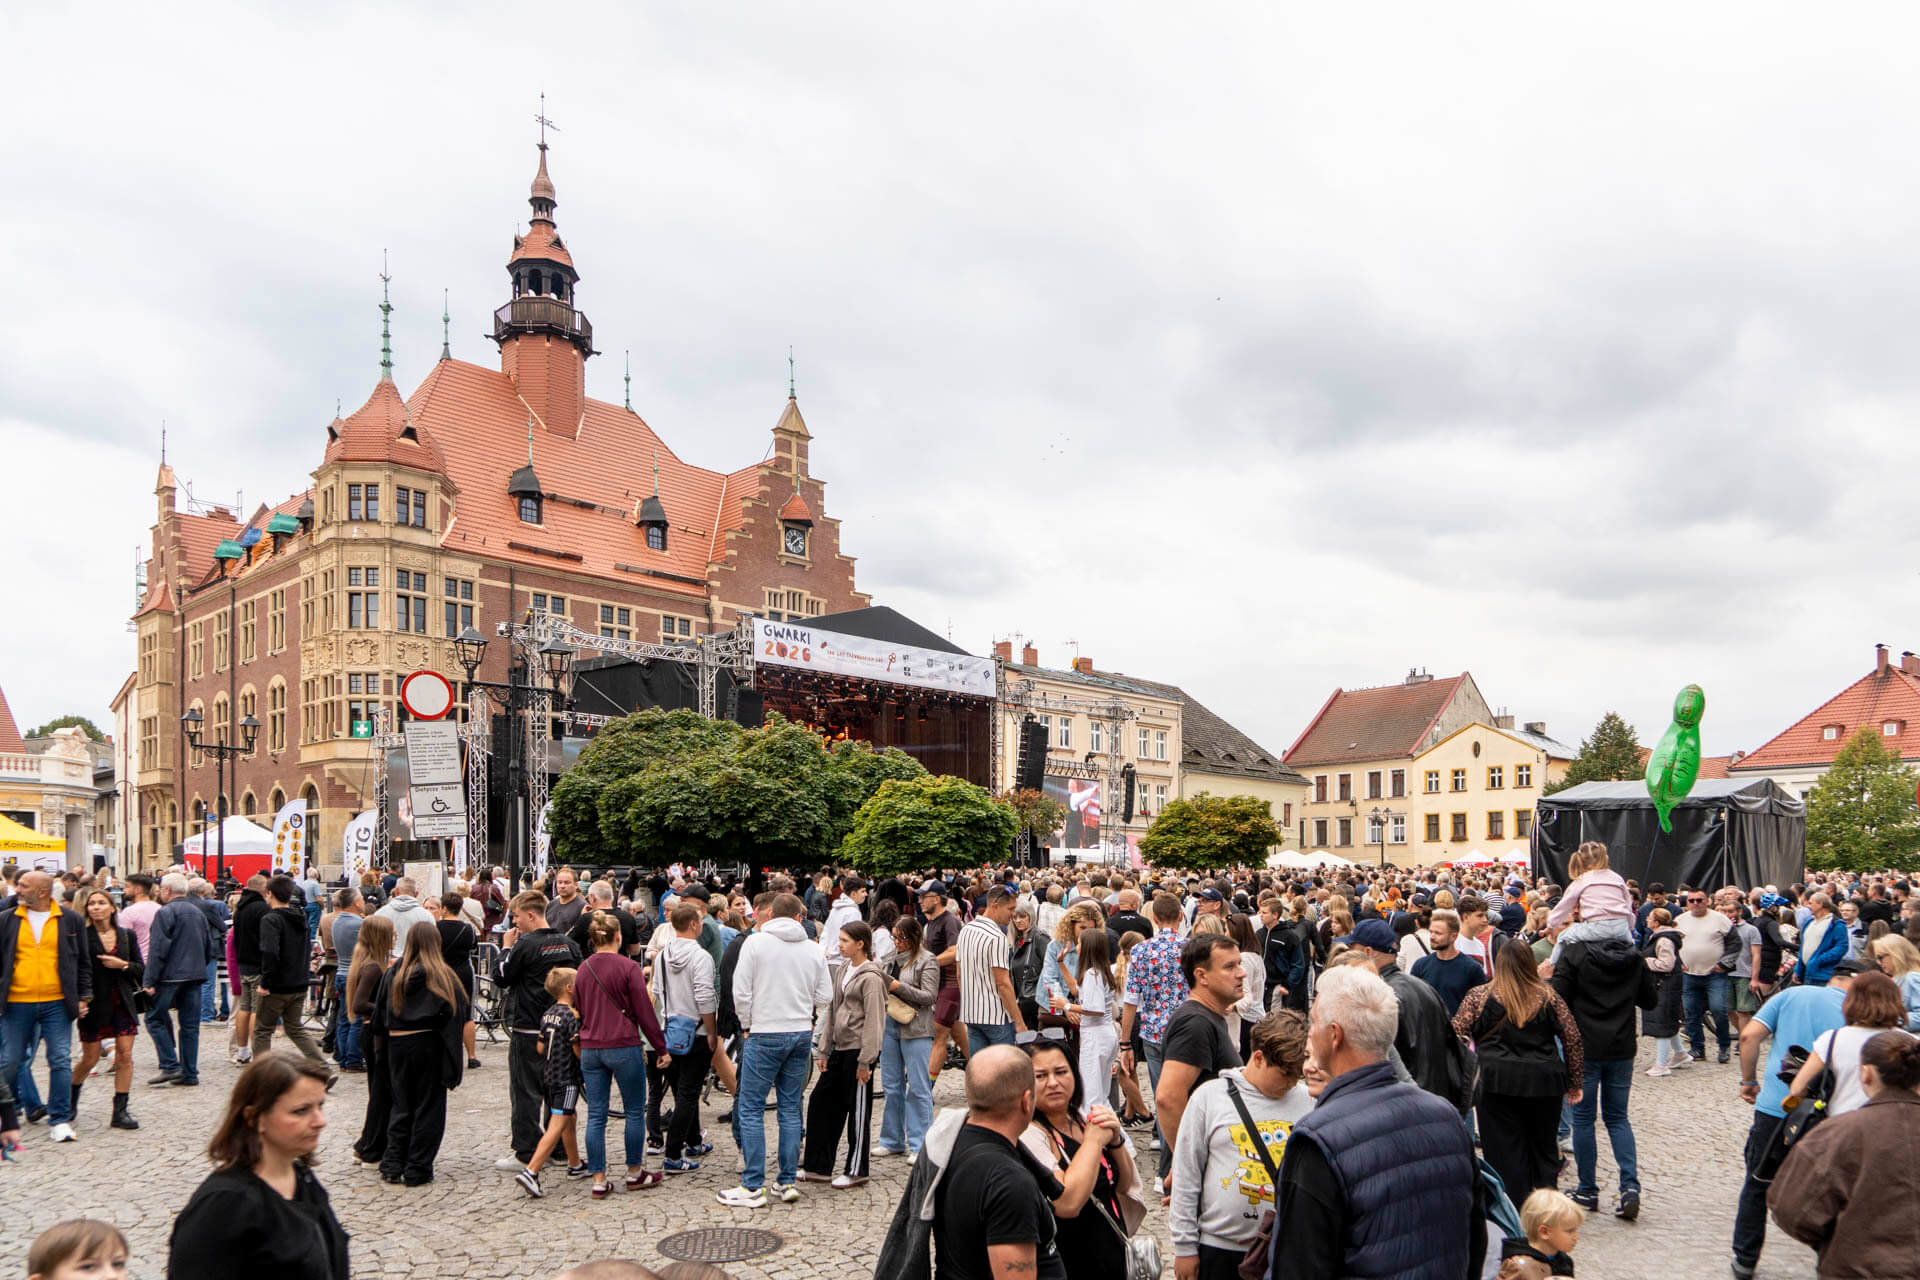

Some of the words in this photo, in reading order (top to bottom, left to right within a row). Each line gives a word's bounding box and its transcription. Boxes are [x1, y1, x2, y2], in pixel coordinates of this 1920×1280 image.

[763, 624, 811, 645] GWARKI
[355, 826, 371, 853] TG
[545, 1027, 556, 1061] 7
